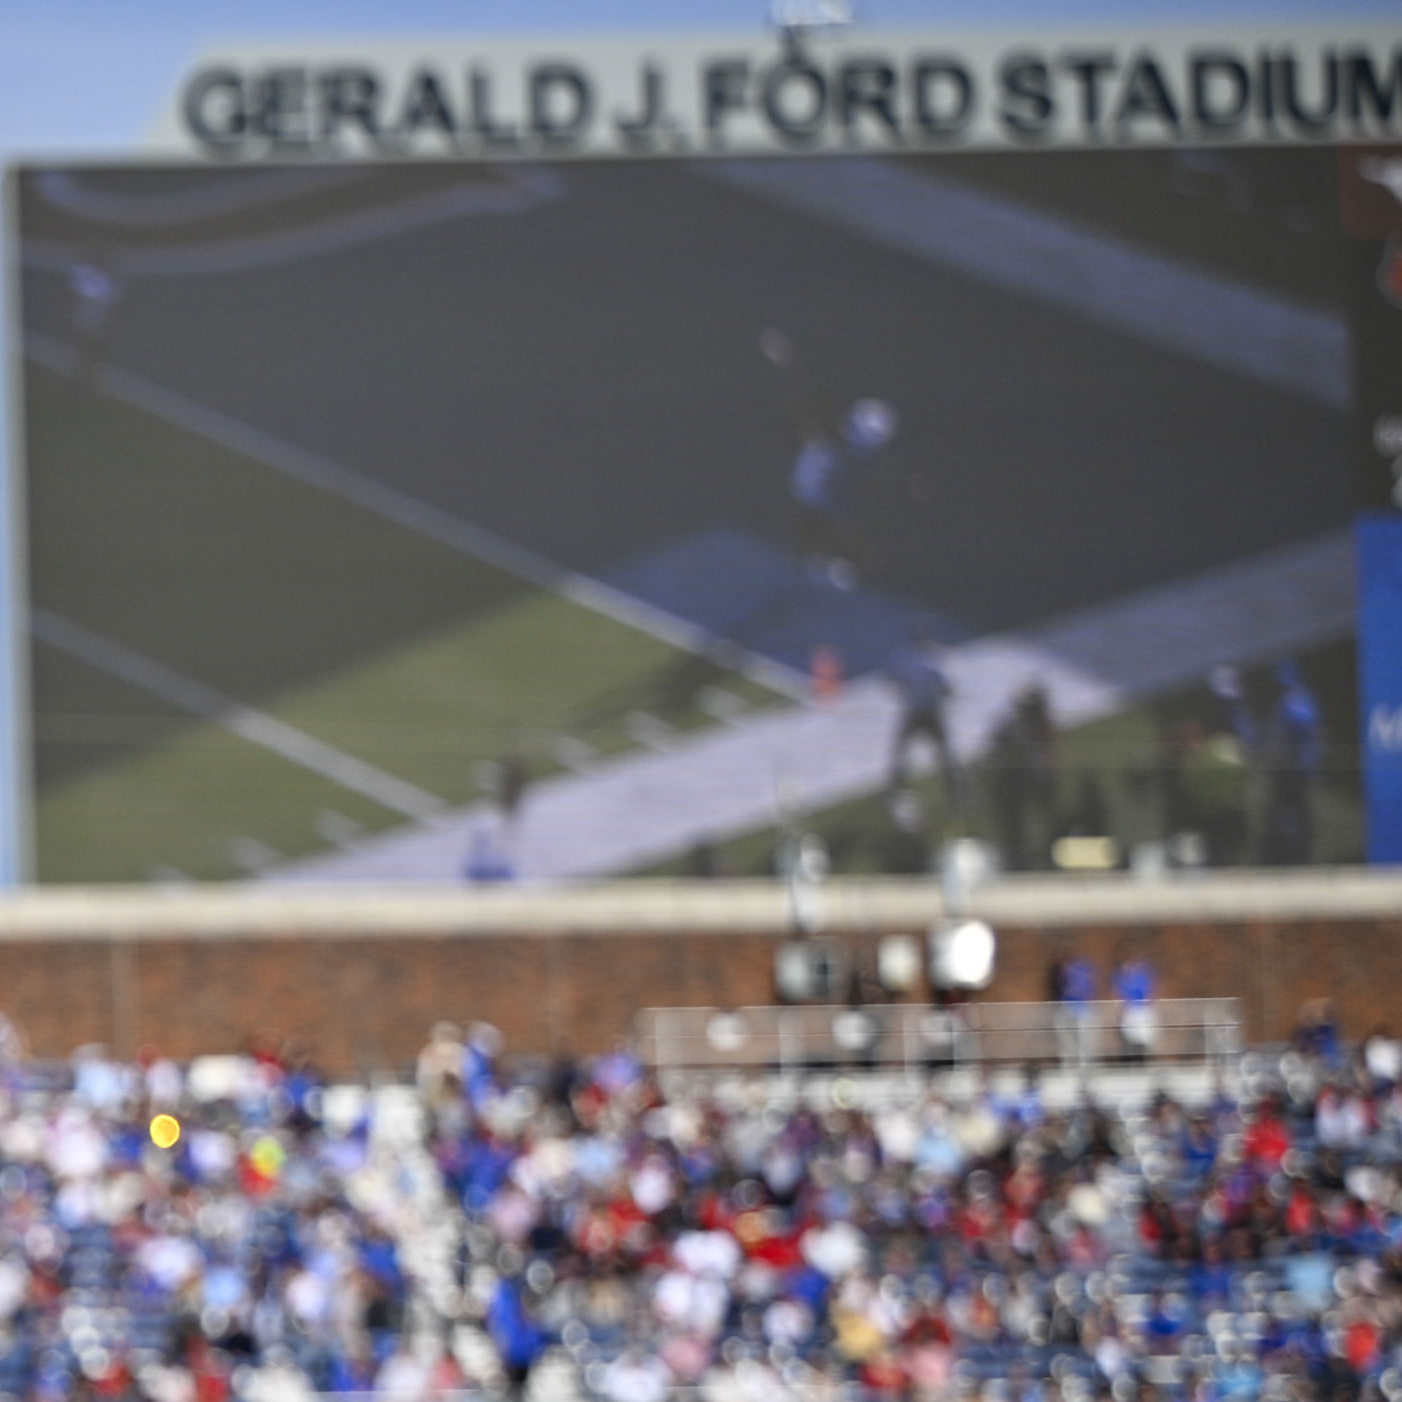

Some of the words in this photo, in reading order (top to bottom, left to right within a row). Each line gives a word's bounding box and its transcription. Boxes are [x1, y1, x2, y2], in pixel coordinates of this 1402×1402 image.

[184, 58, 598, 146] GERALD
[613, 54, 688, 152] J.
[699, 50, 974, 142] FORD
[996, 44, 1402, 138] STADIUM
